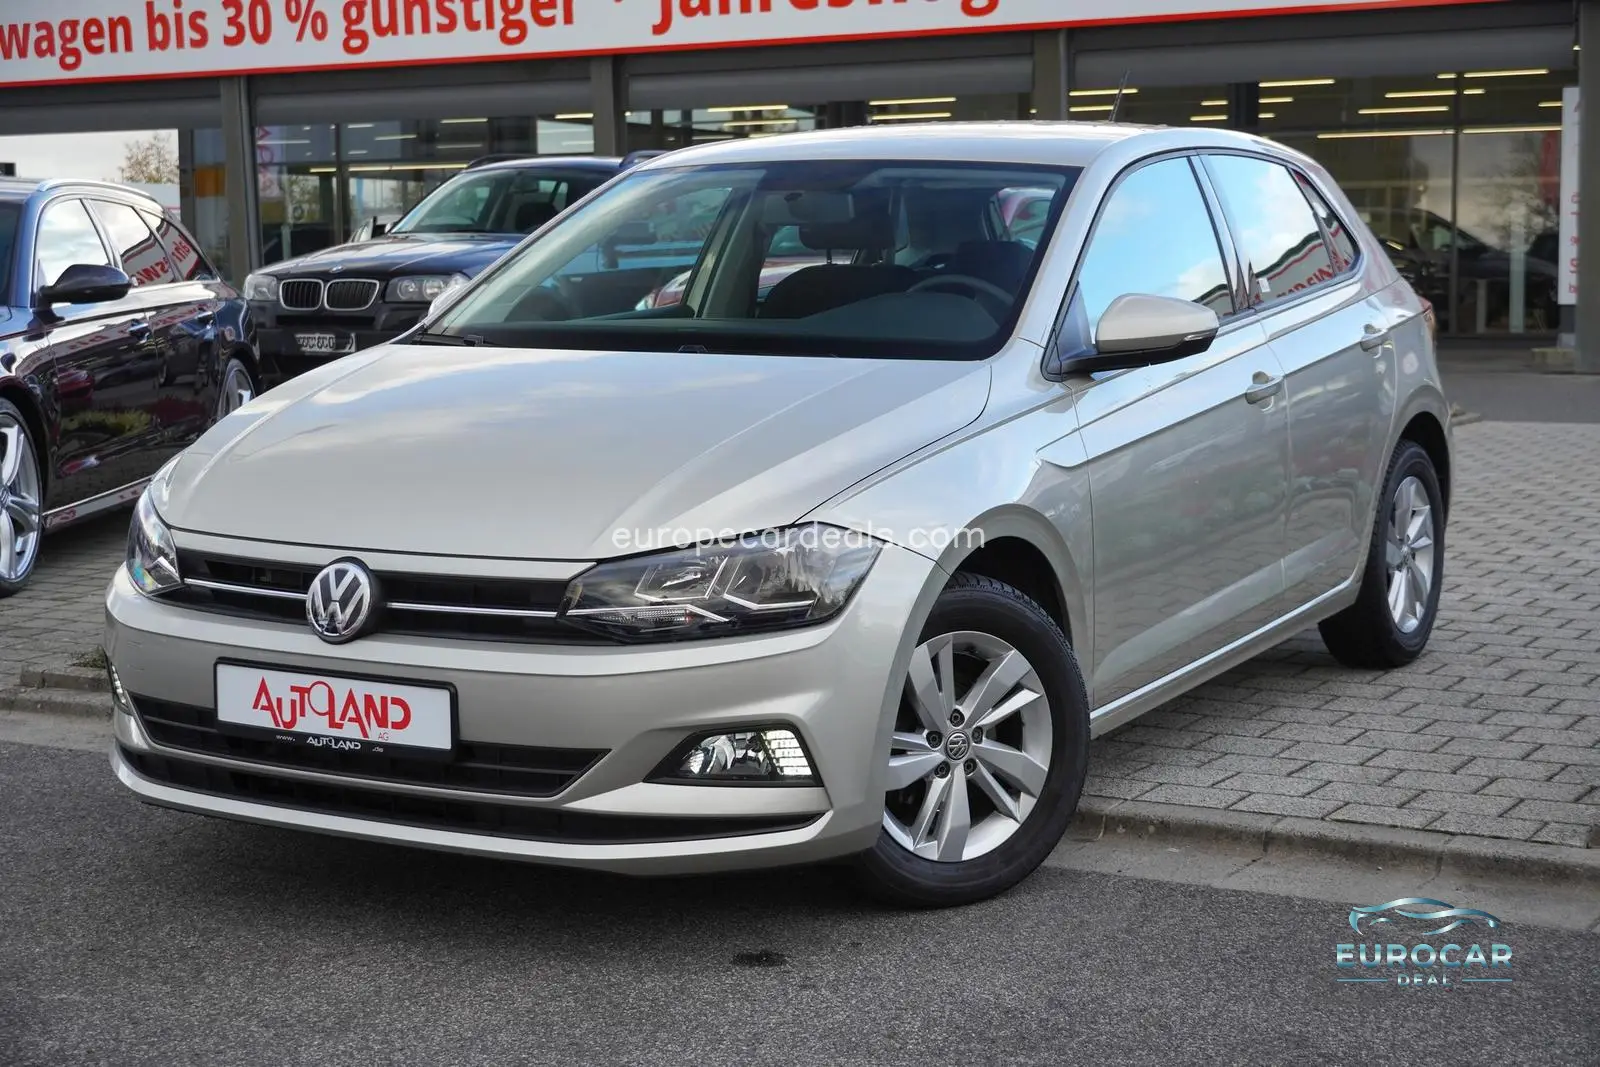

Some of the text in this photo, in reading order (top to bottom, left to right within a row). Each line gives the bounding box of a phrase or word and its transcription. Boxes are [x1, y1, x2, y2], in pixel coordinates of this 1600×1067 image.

[0, 16, 133, 71] wagen
[146, 0, 209, 51] bis
[222, 0, 272, 46] 30
[285, 0, 328, 42] %
[378, 732, 389, 742] AG
